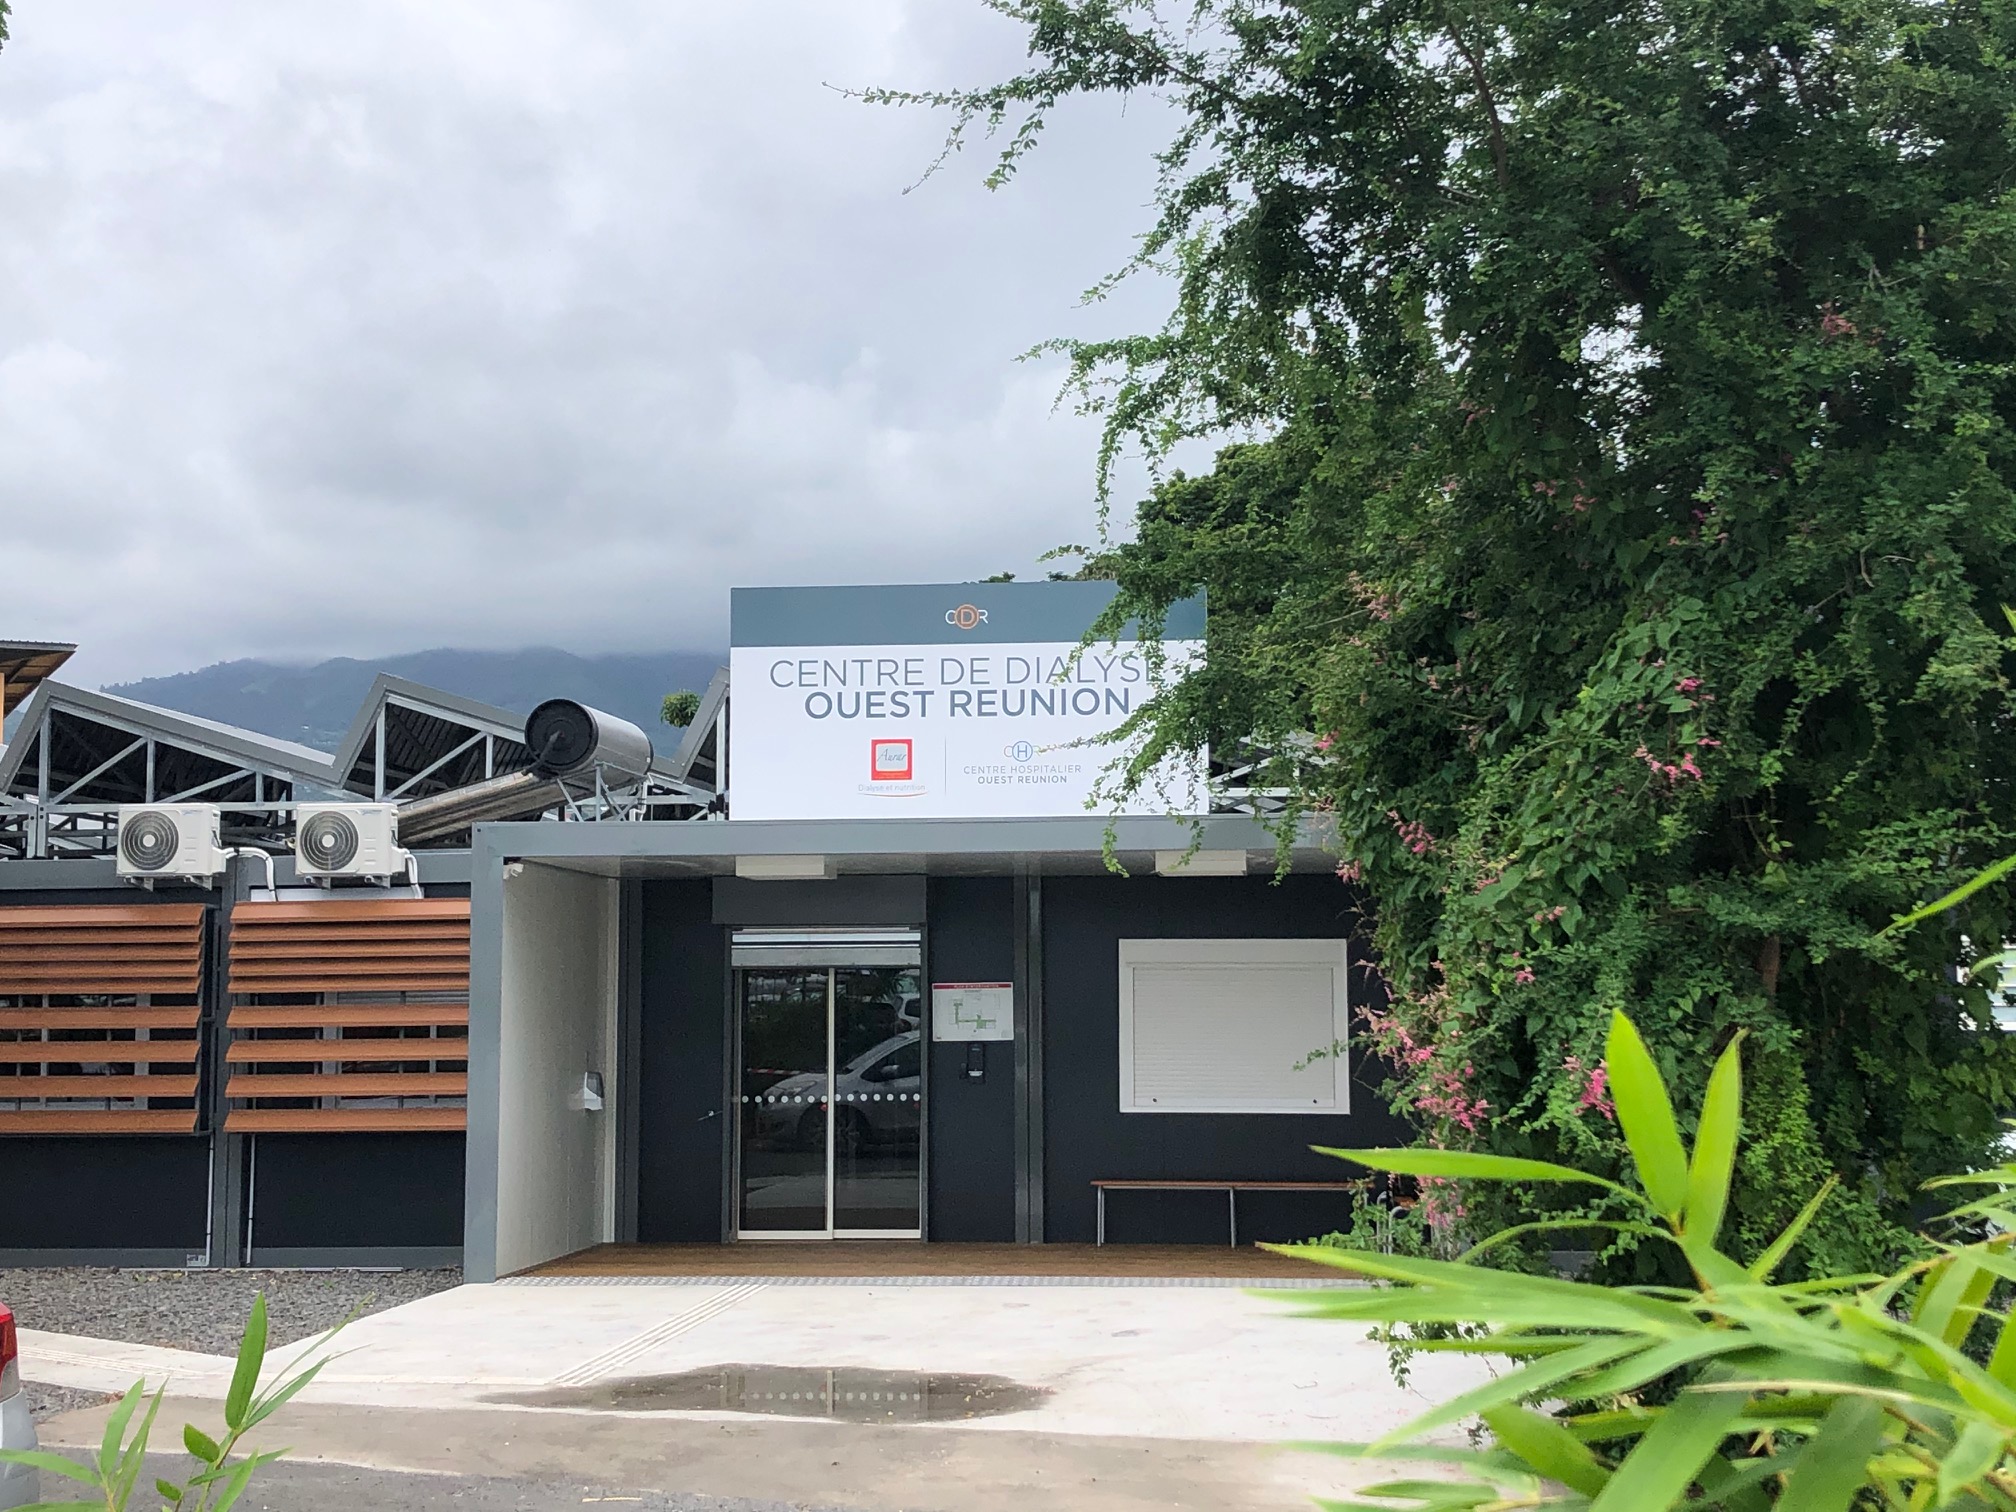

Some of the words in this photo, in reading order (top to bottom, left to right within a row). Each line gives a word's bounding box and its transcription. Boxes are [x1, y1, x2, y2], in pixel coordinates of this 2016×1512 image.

[770, 658, 925, 688] CENTRE
[940, 657, 990, 686] DE
[804, 690, 935, 719] OUEST
[949, 687, 1130, 717] REUNION
[963, 765, 1006, 775] CENTRE
[1010, 764, 1082, 774] HOSPITALIER
[977, 776, 1014, 785] OUEST
[1017, 775, 1068, 784] REUNION
